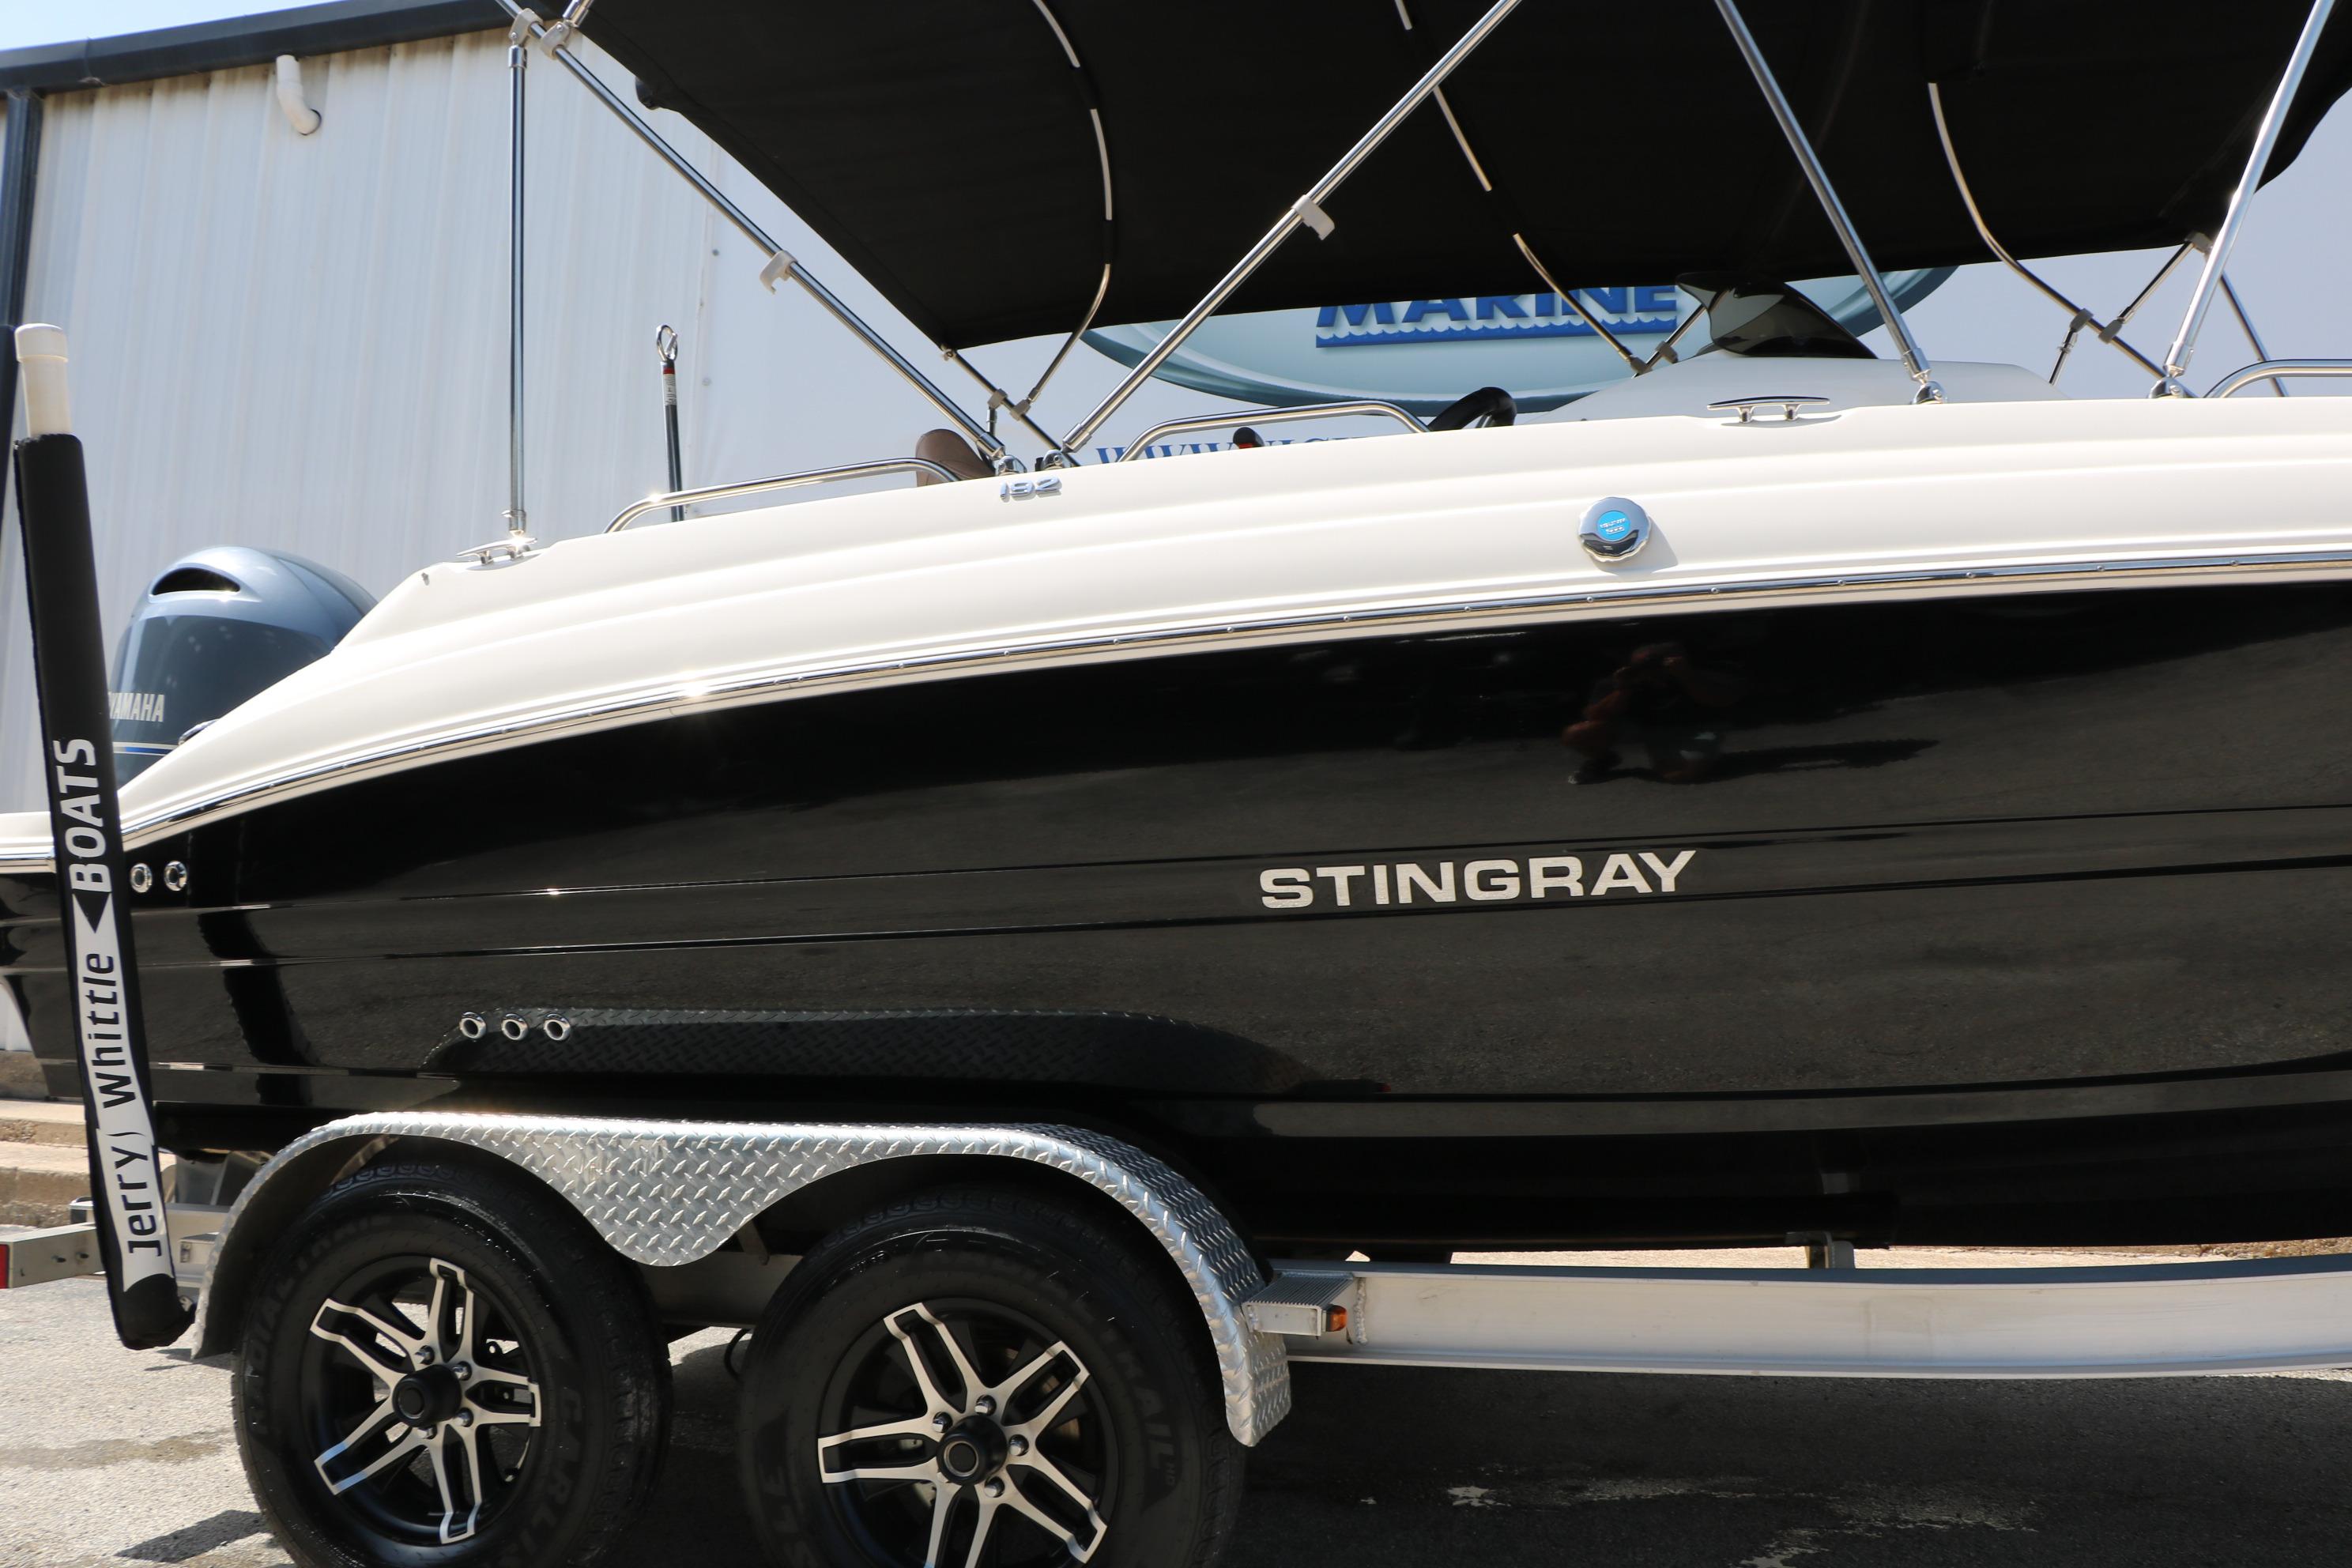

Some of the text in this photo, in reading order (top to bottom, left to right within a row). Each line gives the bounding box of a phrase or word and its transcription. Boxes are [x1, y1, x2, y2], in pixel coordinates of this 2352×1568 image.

[1000, 477, 1062, 499] 192
[1259, 850, 1697, 909] STINGRAY
[53, 739, 161, 1258] Jerry Whittle BOATS
